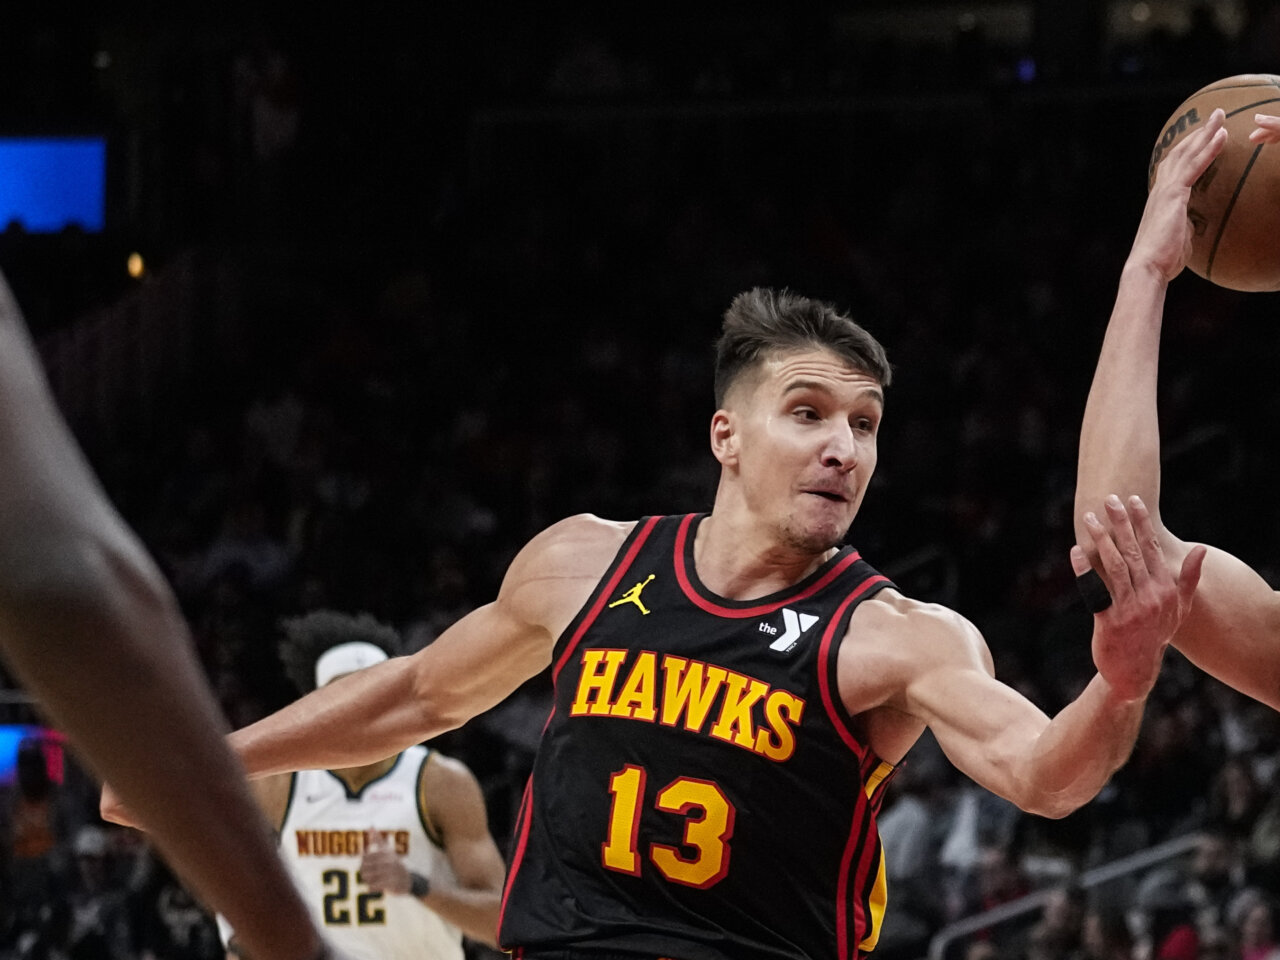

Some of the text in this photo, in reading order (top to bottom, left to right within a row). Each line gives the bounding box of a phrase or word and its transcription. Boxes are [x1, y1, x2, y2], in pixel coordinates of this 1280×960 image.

[758, 621, 777, 636] the
[569, 648, 806, 762] HAWKS
[601, 763, 736, 890] 13
[322, 868, 387, 927] 22
